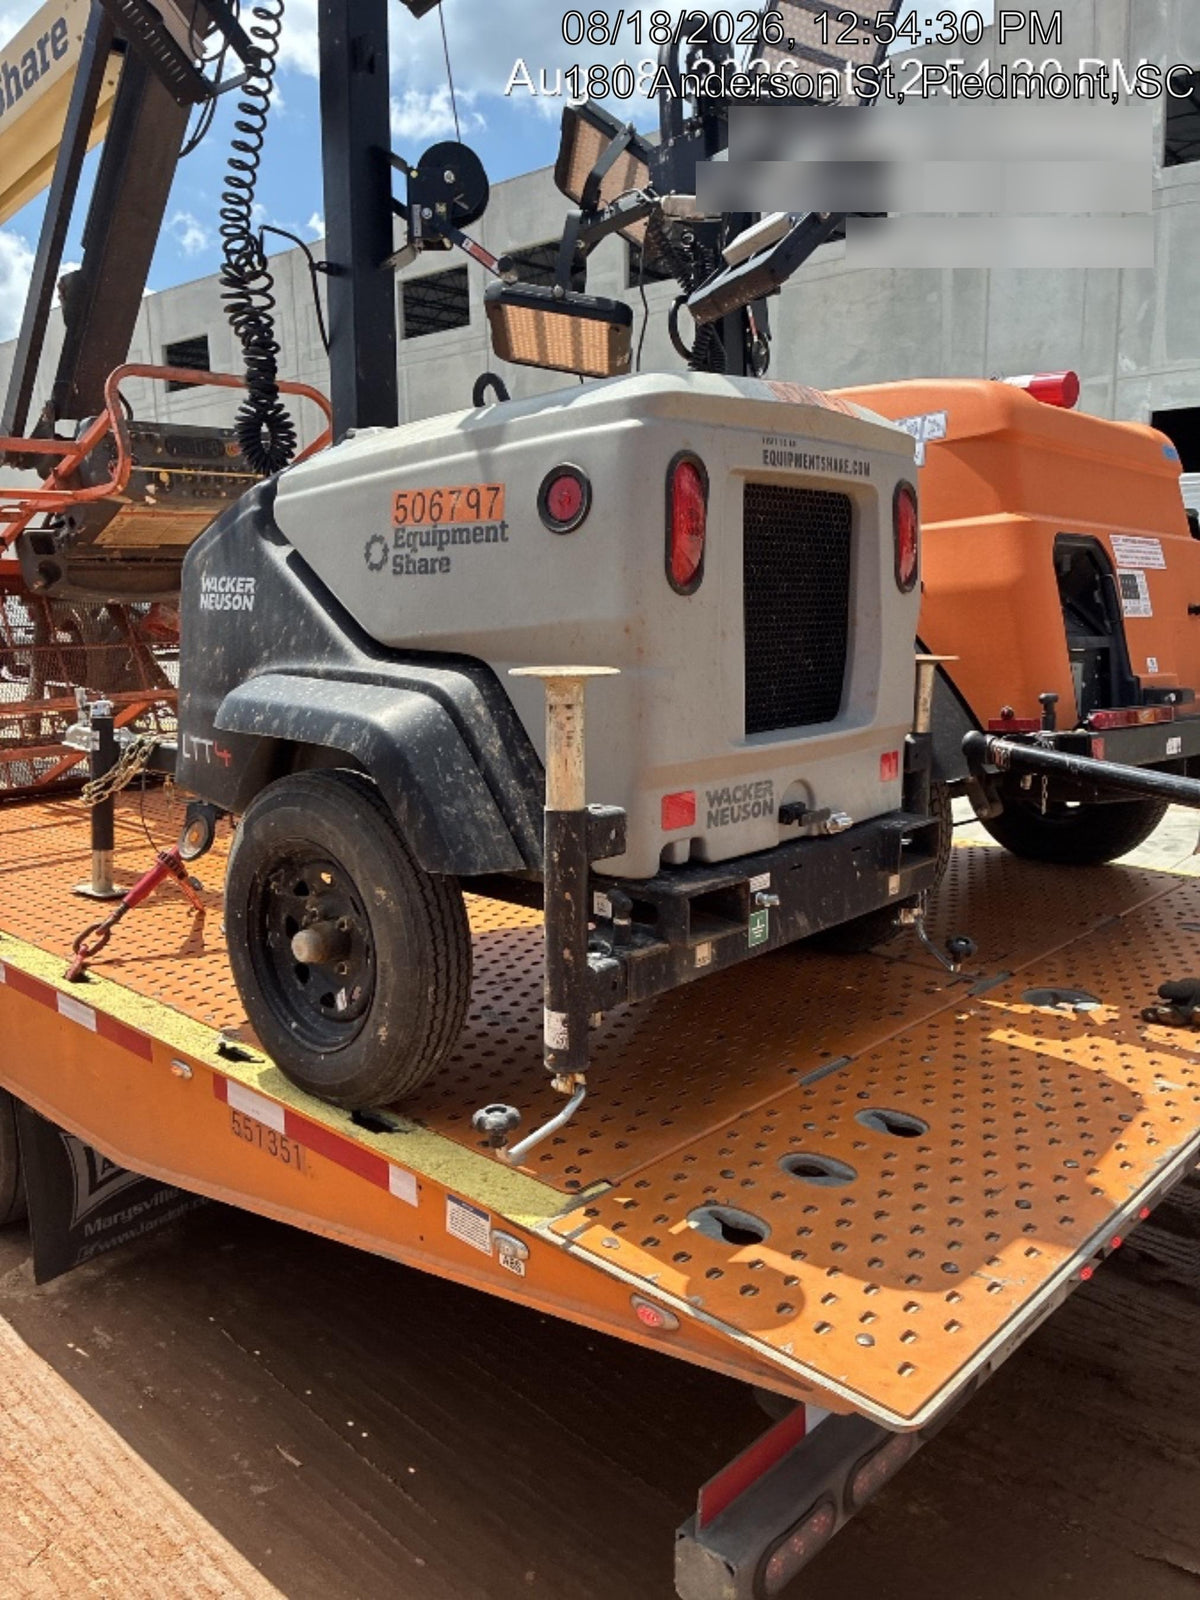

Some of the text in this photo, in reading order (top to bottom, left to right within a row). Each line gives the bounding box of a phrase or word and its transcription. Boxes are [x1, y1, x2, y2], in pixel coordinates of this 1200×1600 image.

[762, 449, 871, 477] EQUIPMENTSHARE.COM
[394, 487, 501, 524] 506797
[393, 523, 509, 551] Equipment
[392, 554, 450, 575] Share
[201, 577, 256, 593] WACKER
[200, 593, 254, 611] NEUSON
[705, 780, 774, 808] WACKER
[706, 798, 774, 829] NEUSON
[231, 1110, 301, 1171] 551351
